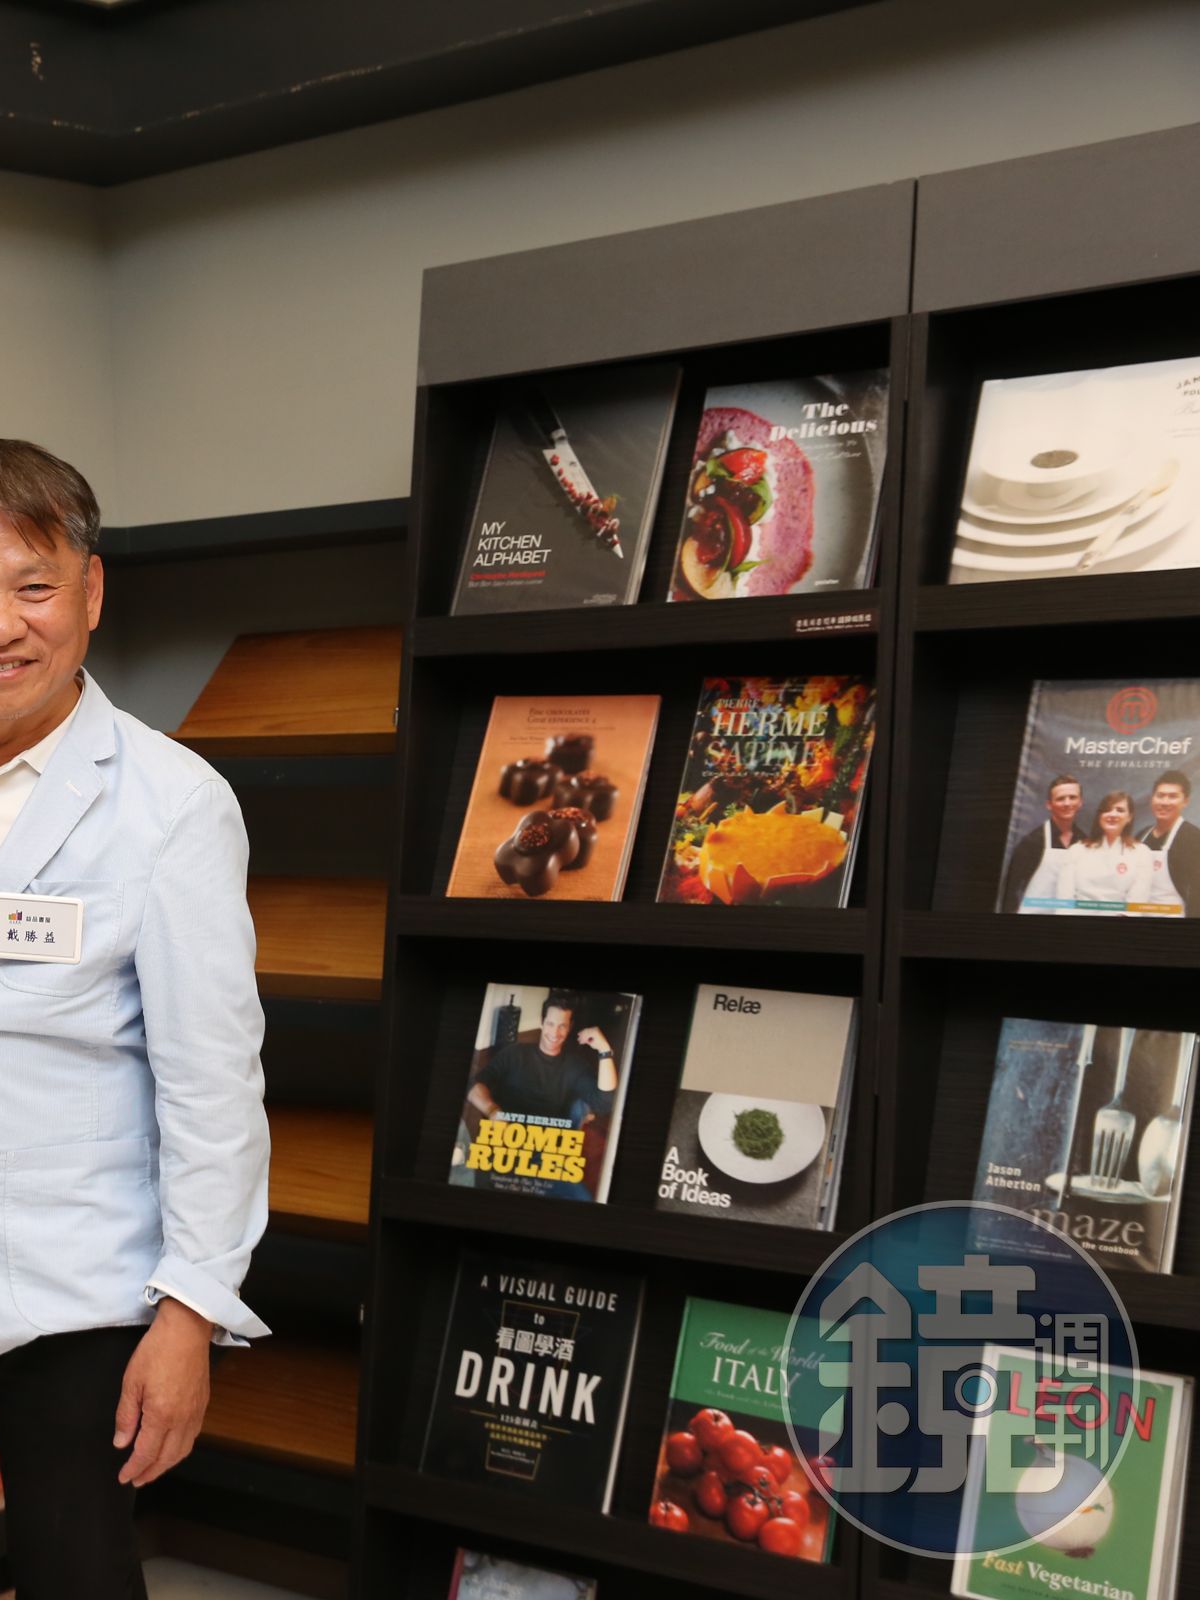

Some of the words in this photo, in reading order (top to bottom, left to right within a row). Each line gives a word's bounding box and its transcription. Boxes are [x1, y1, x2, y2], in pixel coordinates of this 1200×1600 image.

[801, 402, 850, 420] The
[769, 420, 878, 441] Delicious
[481, 521, 506, 536] MY
[478, 534, 542, 551] KITCHEN
[473, 549, 552, 567] ALPHABET
[1066, 736, 1192, 755] MasterChef
[1079, 759, 1102, 768] THE
[1107, 759, 1171, 768] FINALISTS
[7, 928, 55, 943] 戴勝益
[713, 994, 762, 1015] Relæ
[526, 1115, 572, 1128] BERKUS
[476, 1119, 585, 1156] HOME
[465, 1143, 586, 1184] RULES
[665, 1147, 679, 1164] A
[661, 1164, 710, 1187] Book
[987, 1162, 1022, 1177] Jason
[985, 1176, 1041, 1193] Atherton
[658, 1183, 679, 1199] of
[680, 1184, 732, 1208] Ideas
[1030, 1208, 1145, 1247] maze
[1082, 1241, 1097, 1250] the
[1098, 1244, 1139, 1257] cookbook
[480, 1275, 489, 1288] A
[499, 1274, 556, 1301] VISUAL
[564, 1286, 619, 1312] GUIDE
[533, 1313, 546, 1325] to
[495, 1327, 576, 1362] 看圖學酒
[700, 1331, 751, 1355] Food
[455, 1349, 602, 1425] DRINK
[712, 1356, 801, 1398] ITALY
[1008, 1371, 1156, 1441] LEON
[982, 1552, 1024, 1575] Fast
[1026, 1561, 1136, 1600] Vegetarian
